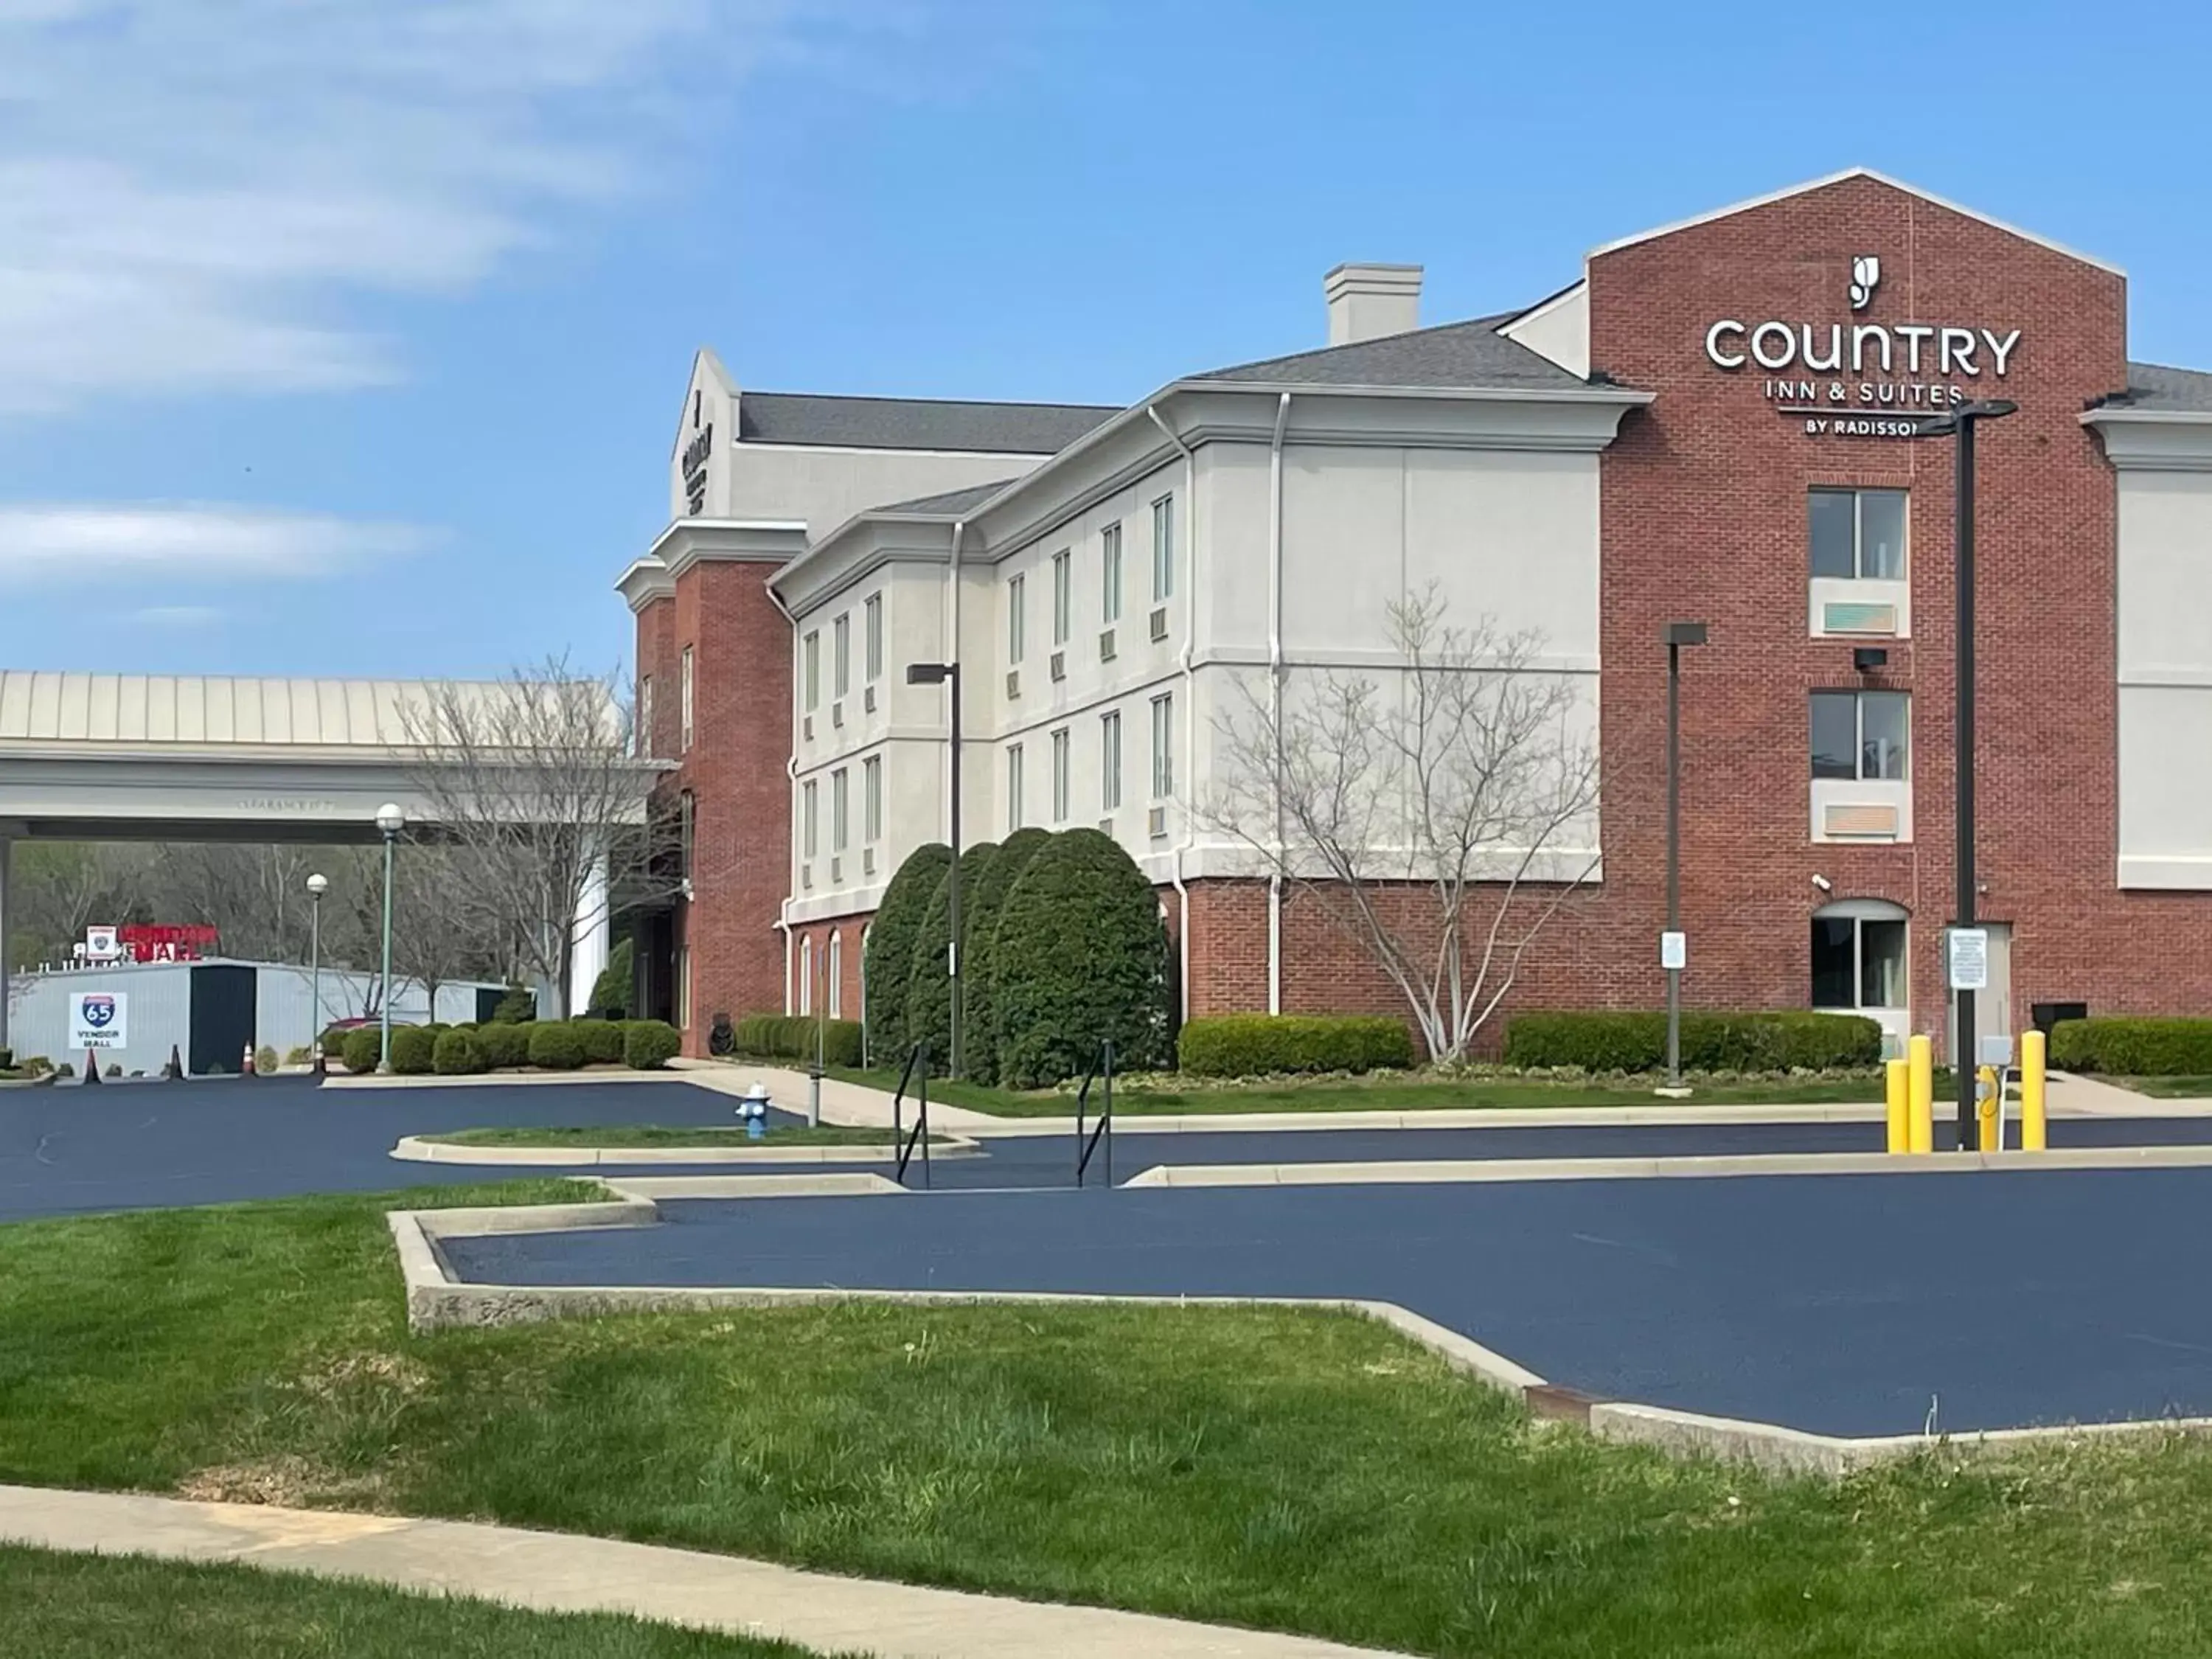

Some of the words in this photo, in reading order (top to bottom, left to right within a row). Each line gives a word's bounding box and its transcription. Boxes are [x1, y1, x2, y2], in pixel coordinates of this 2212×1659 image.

[1705, 319, 2021, 376] COUNTRY
[1765, 380, 1816, 400] INN
[1828, 382, 1846, 400] &
[1860, 383, 1963, 404] SUITES
[1806, 420, 1828, 434] BY
[86, 1005, 111, 1021] 65
